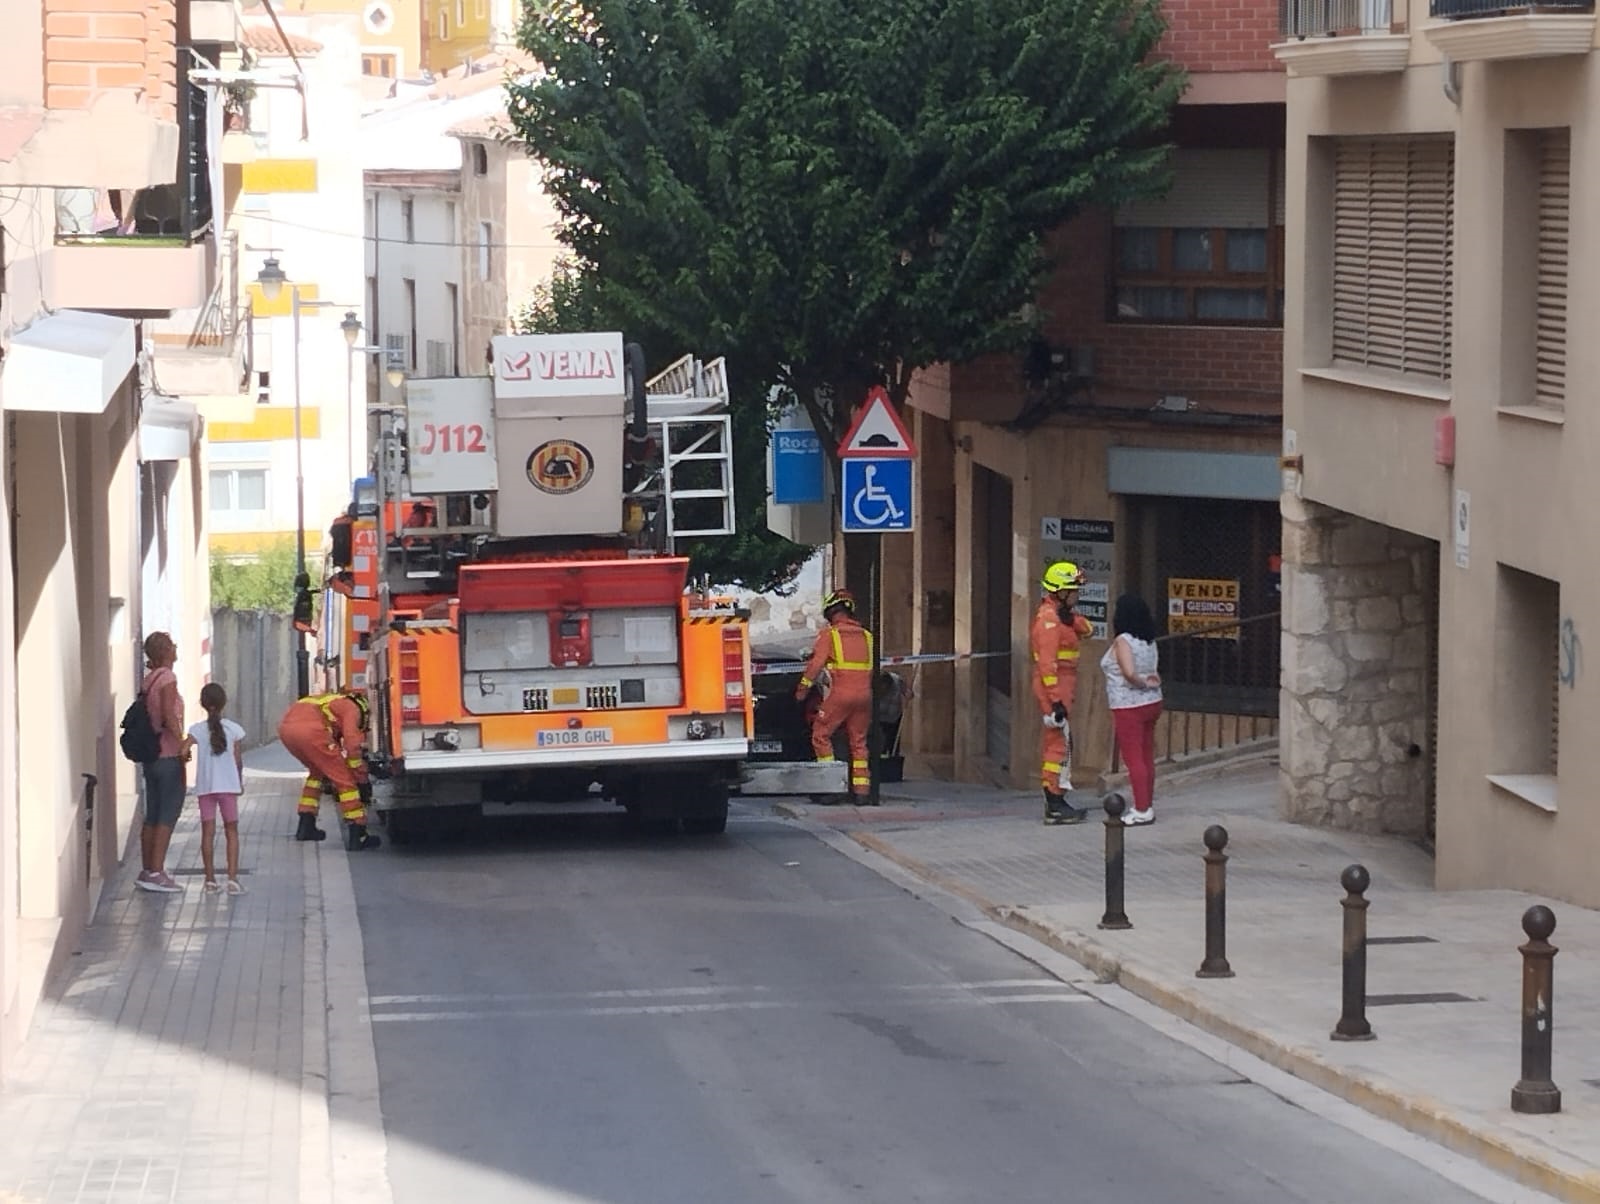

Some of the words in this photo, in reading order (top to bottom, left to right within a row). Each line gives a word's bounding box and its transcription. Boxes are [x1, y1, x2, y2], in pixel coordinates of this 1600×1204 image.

[535, 350, 616, 380] VEMA
[438, 424, 487, 453] 112
[778, 436, 819, 449] Roca
[1172, 583, 1236, 598] VENDE
[545, 731, 580, 745] 9108
[584, 730, 611, 743] GHL
